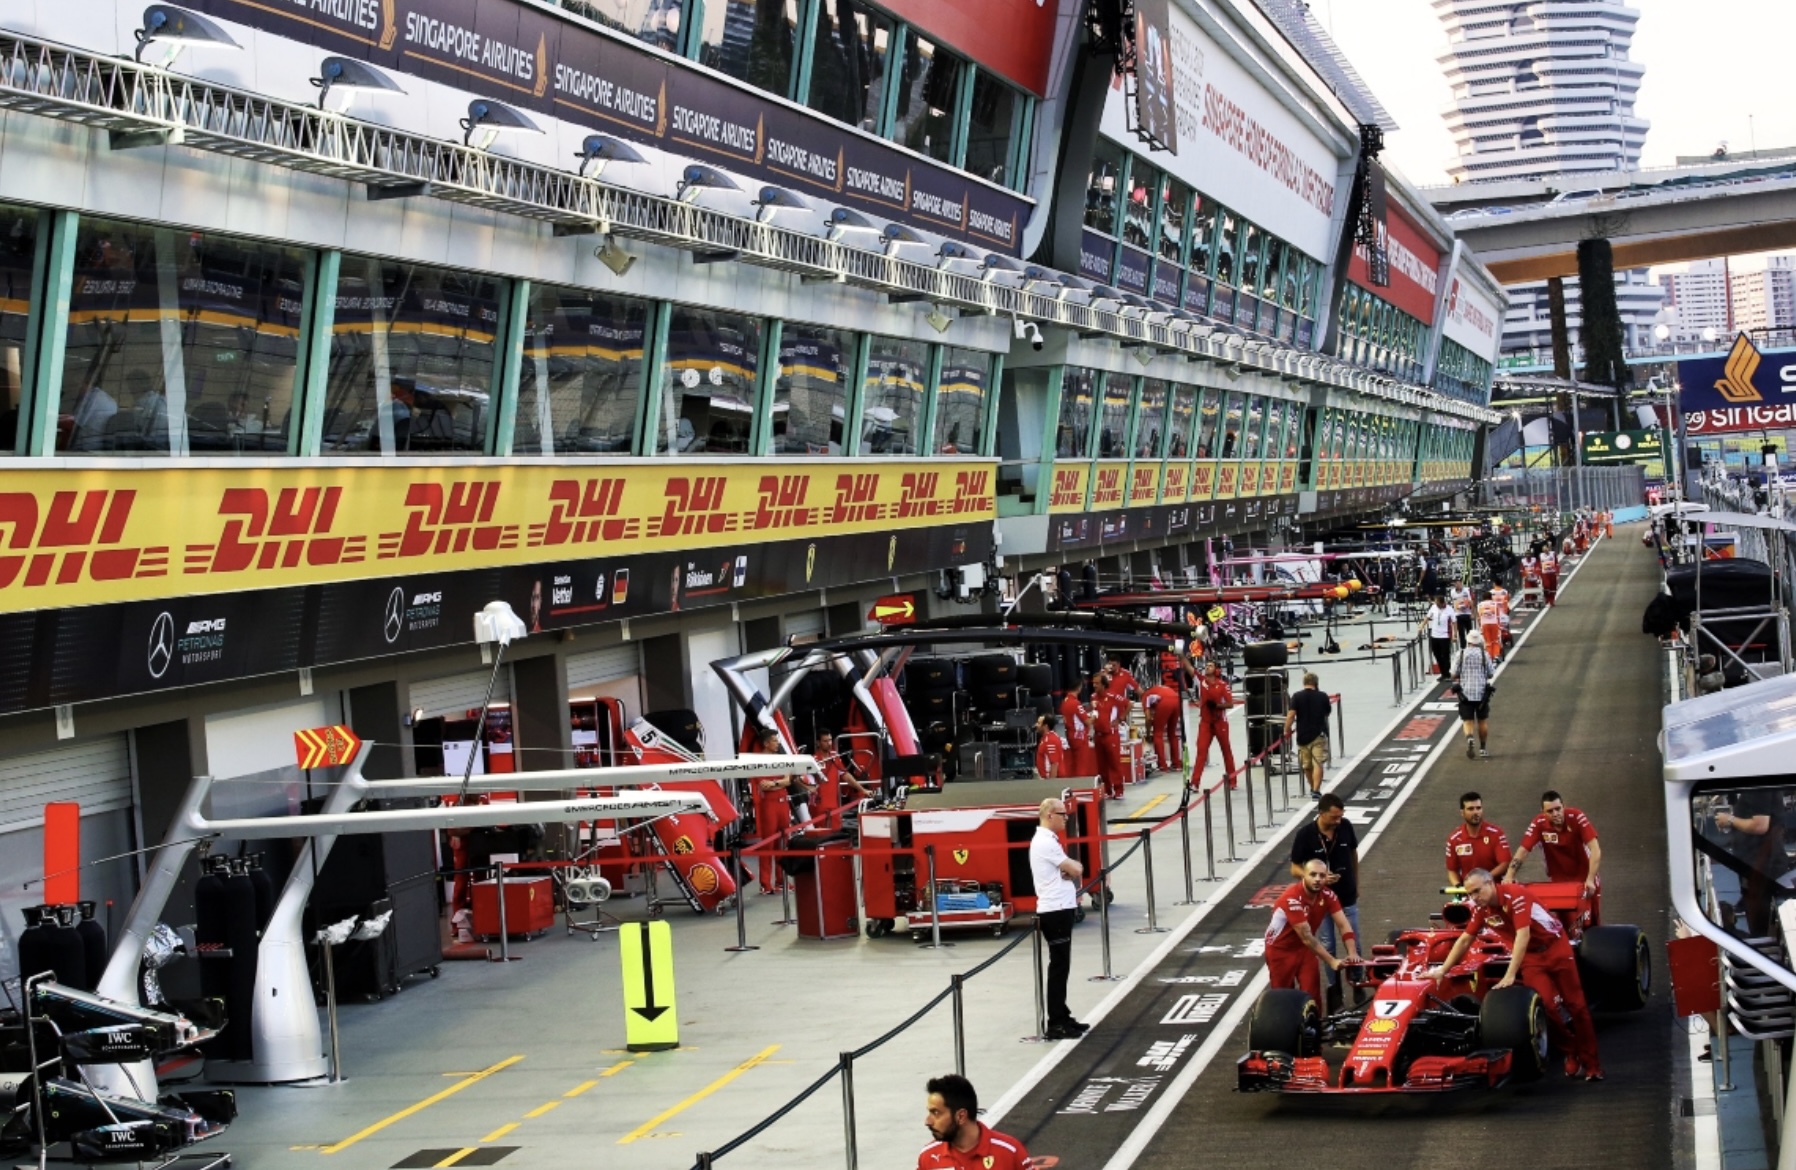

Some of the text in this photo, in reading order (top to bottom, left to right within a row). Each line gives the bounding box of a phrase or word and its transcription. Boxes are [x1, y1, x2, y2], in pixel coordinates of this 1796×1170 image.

[405, 11, 533, 80] SINGAPORE AIRLINES
[554, 64, 656, 122] SINGAPORE AIRLINES
[672, 105, 755, 152] SINGAPORE AIRLINES
[767, 137, 837, 181] SINGAPORE AIRLINES
[660, 477, 727, 537] DHL
[754, 475, 810, 530] DHL
[833, 473, 879, 524] DHL
[898, 472, 939, 518] DHL
[953, 470, 988, 515] DHL
[1051, 470, 1081, 506] DHL
[1093, 469, 1120, 503] DHL
[211, 486, 344, 573] DHL
[399, 481, 502, 558] DHL
[544, 478, 626, 546] DHL
[0, 489, 141, 590] DHL
[178, 634, 224, 651] PETRONAS
[188, 618, 226, 634] AMG
[182, 649, 222, 664] MOTORSPORT
[1384, 1002, 1399, 1015] 7
[108, 1032, 133, 1044] IWC
[111, 1130, 136, 1142] IWC
